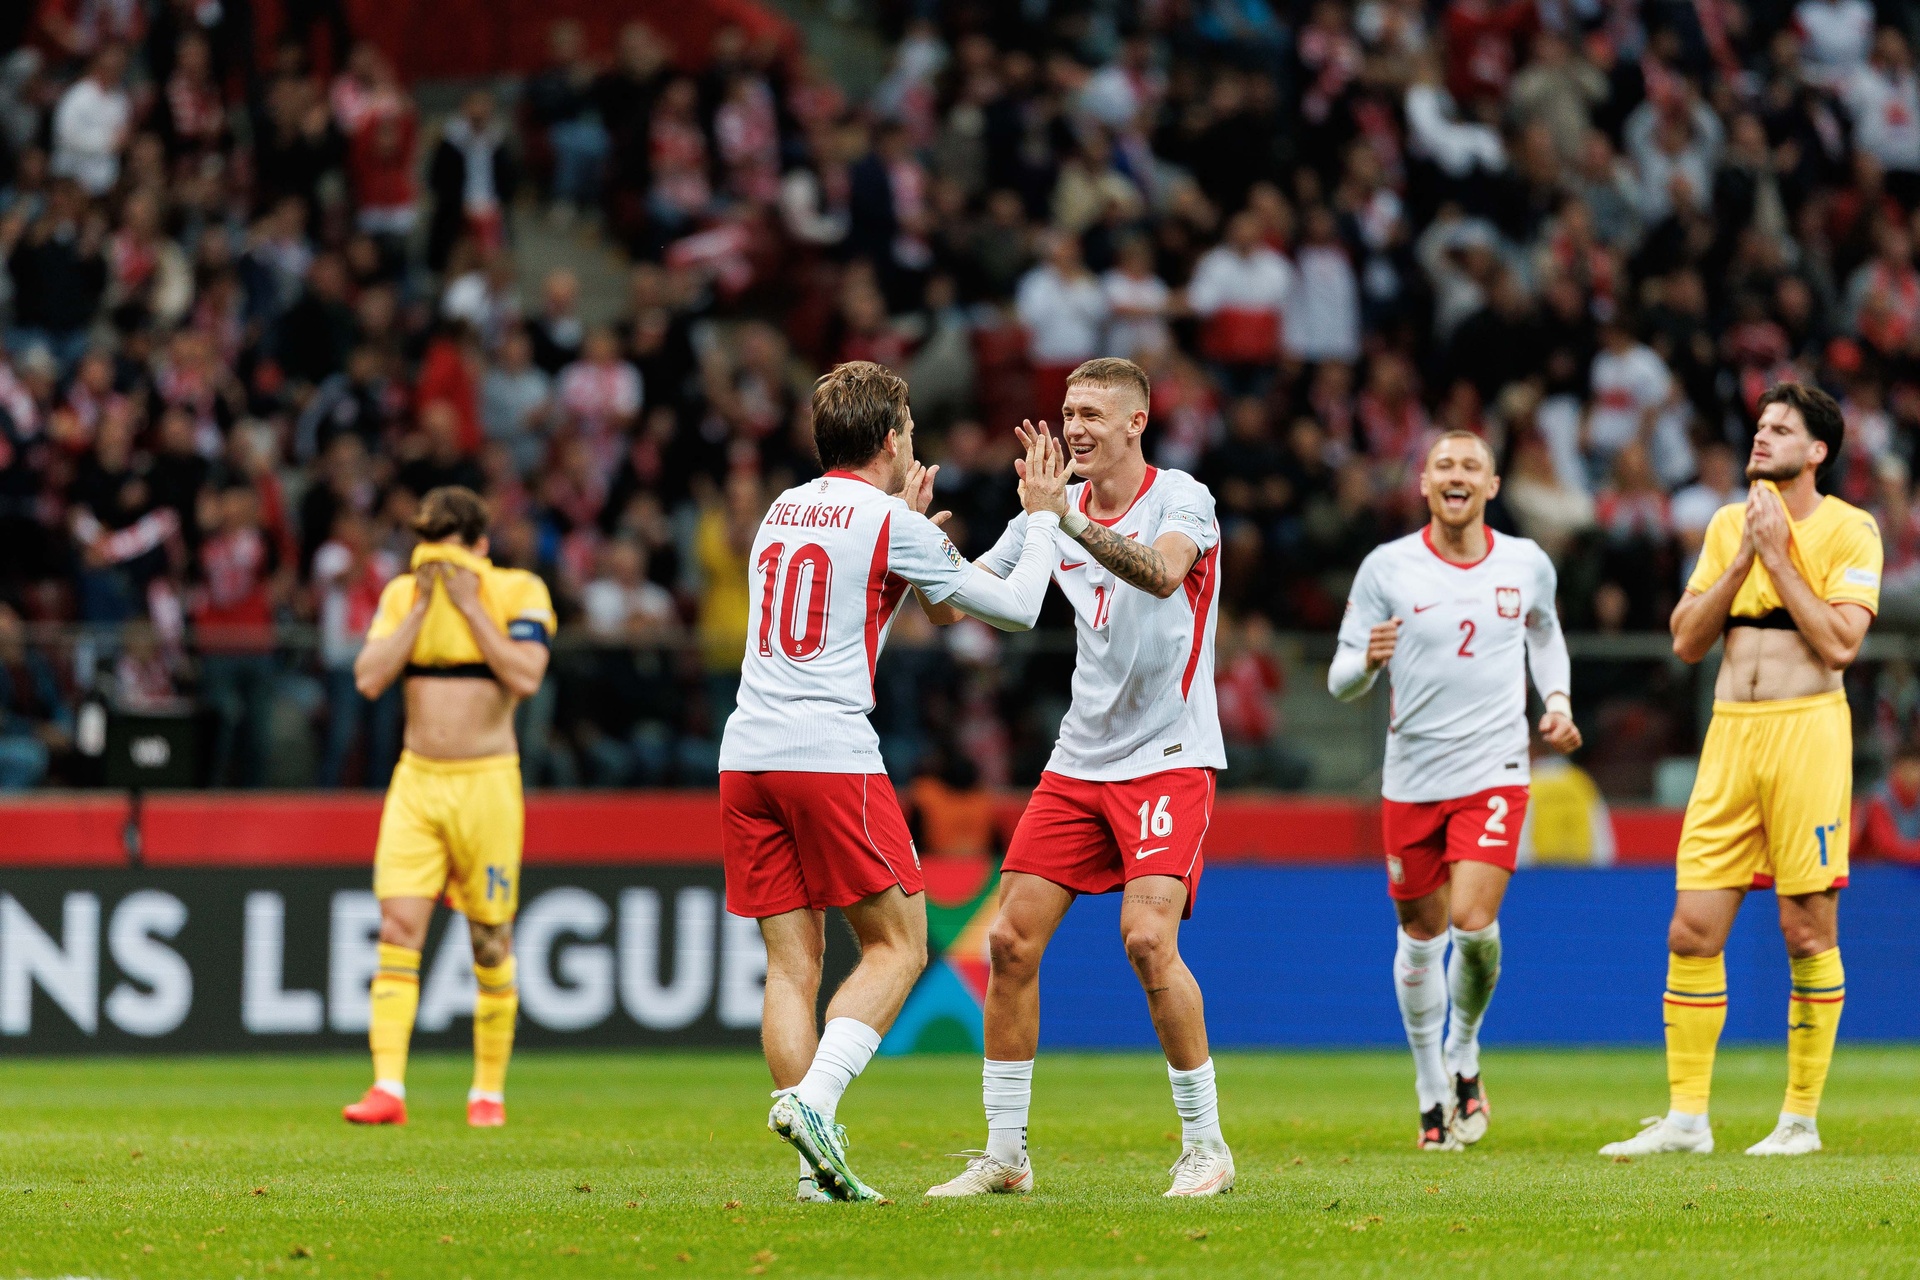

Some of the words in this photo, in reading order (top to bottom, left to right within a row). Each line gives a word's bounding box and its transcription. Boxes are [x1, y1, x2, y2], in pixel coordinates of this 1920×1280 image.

[766, 502, 854, 529] ZIELIŃSKI
[757, 542, 833, 662] 10
[1458, 620, 1476, 657] 2
[1138, 795, 1173, 841] 16
[1484, 795, 1508, 834] 2
